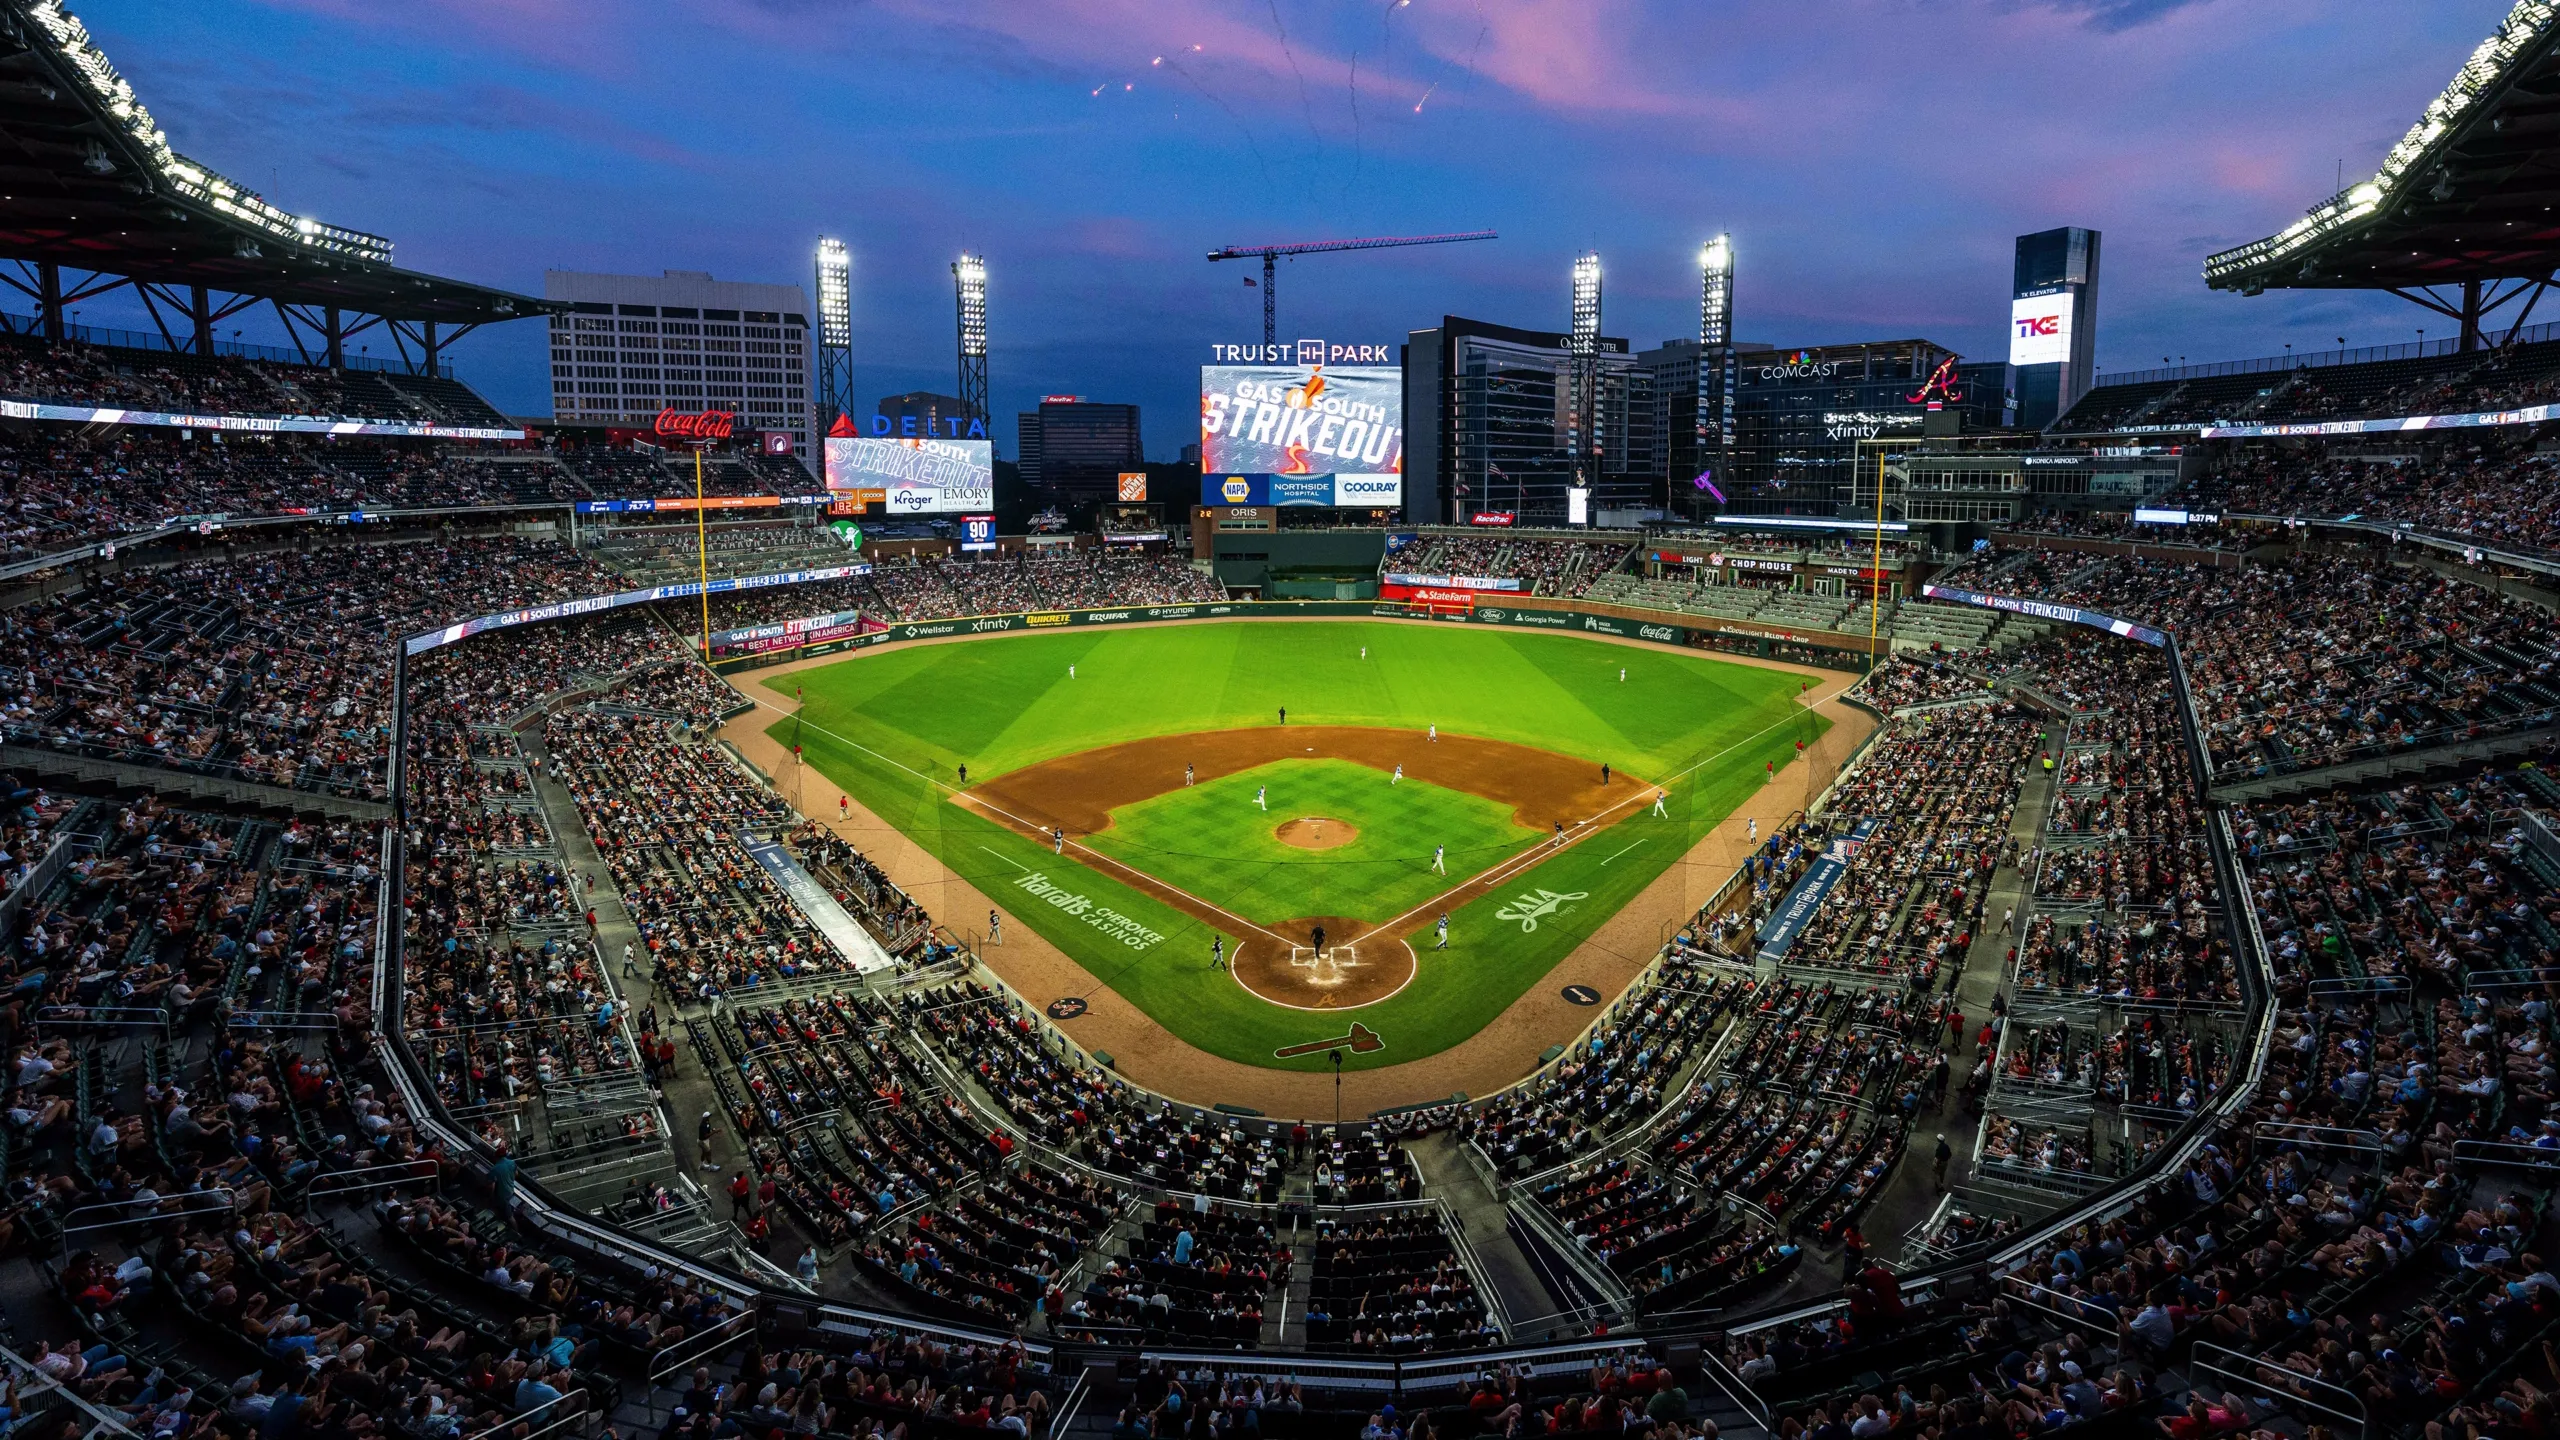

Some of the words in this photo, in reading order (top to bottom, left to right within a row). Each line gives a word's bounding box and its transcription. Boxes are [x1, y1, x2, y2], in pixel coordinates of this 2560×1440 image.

[2029, 288, 2057, 297] ELEVATOR
[2015, 315, 2059, 337] TKE
[1212, 344, 1292, 361] TRUIST
[1331, 345, 1389, 361] PARK
[1600, 342, 1619, 352] OTEL
[1761, 363, 1839, 379] COMCAST
[1236, 381, 1284, 404] GAS
[1309, 394, 1386, 425] SOUTH
[170, 416, 186, 425] GAS
[194, 417, 218, 427] SOUTH
[220, 417, 283, 431] STRIKEOUT
[872, 415, 986, 437] DELTA
[2478, 414, 2498, 424] GAS
[408, 427, 424, 435] GAS
[432, 428, 455, 437] SOUTH
[458, 428, 503, 439] STRIKEOUT
[1826, 423, 1880, 440] xfinity
[2261, 427, 2280, 435] GAS
[2289, 425, 2319, 434] SOUTH
[2320, 420, 2366, 434] STRIKEOUT
[917, 438, 972, 463] SOUTH
[832, 438, 991, 488] STRIKEOUT
[943, 488, 990, 499] EMORY
[1119, 473, 1145, 501] HOME
[1226, 484, 1246, 496] NAPA
[1274, 483, 1330, 491] NORTHSIDE
[1344, 482, 1398, 492] COOLRAY
[894, 490, 933, 510] Kroger
[1231, 508, 1257, 517] ORIS
[1475, 515, 1510, 523] RaceTrac
[2208, 515, 2218, 523] PM
[969, 521, 988, 538] 90
[1682, 555, 1704, 564] LIGHT
[1731, 559, 1757, 568] CHOP
[1759, 561, 1792, 571] HOUSE
[1827, 567, 1847, 575] MADE
[1848, 568, 1858, 576] TO
[1428, 577, 1450, 585] SOUTH
[1452, 576, 1499, 589] STRIKEOUT
[501, 613, 519, 624] GAS
[530, 607, 559, 620] SOUTH
[562, 594, 615, 616] STRIKEOUT
[1162, 607, 1195, 615] HYUNDAI
[1483, 610, 1500, 619] Ford
[1971, 594, 1986, 604] GAS
[1994, 598, 2019, 611] SOUTH
[2022, 600, 2081, 622] STRIKEOUT
[1026, 614, 1071, 624] QUIKRETE
[1089, 612, 1130, 622] EQUIFAX
[1524, 615, 1547, 624] Georgia
[1548, 617, 1566, 625] Power
[731, 630, 749, 641] GAS
[757, 625, 784, 637] SOUTH
[786, 615, 836, 634] STRIKEOUT
[919, 625, 954, 635] Wellstar
[972, 617, 1011, 633] xfinity
[1640, 624, 1674, 641] Coca-Cola
[748, 640, 769, 650] BEST
[821, 626, 855, 638] AMERICA
[1764, 631, 1785, 640] BELOW
[1792, 635, 1809, 644] CHOP
[1013, 872, 1093, 915] Harrah's
[1495, 888, 1589, 933] SAIA
[1080, 913, 1150, 951] CASINOS
[1095, 907, 1165, 944] CHEROKEE
[1566, 1274, 1587, 1308] TRUIST
